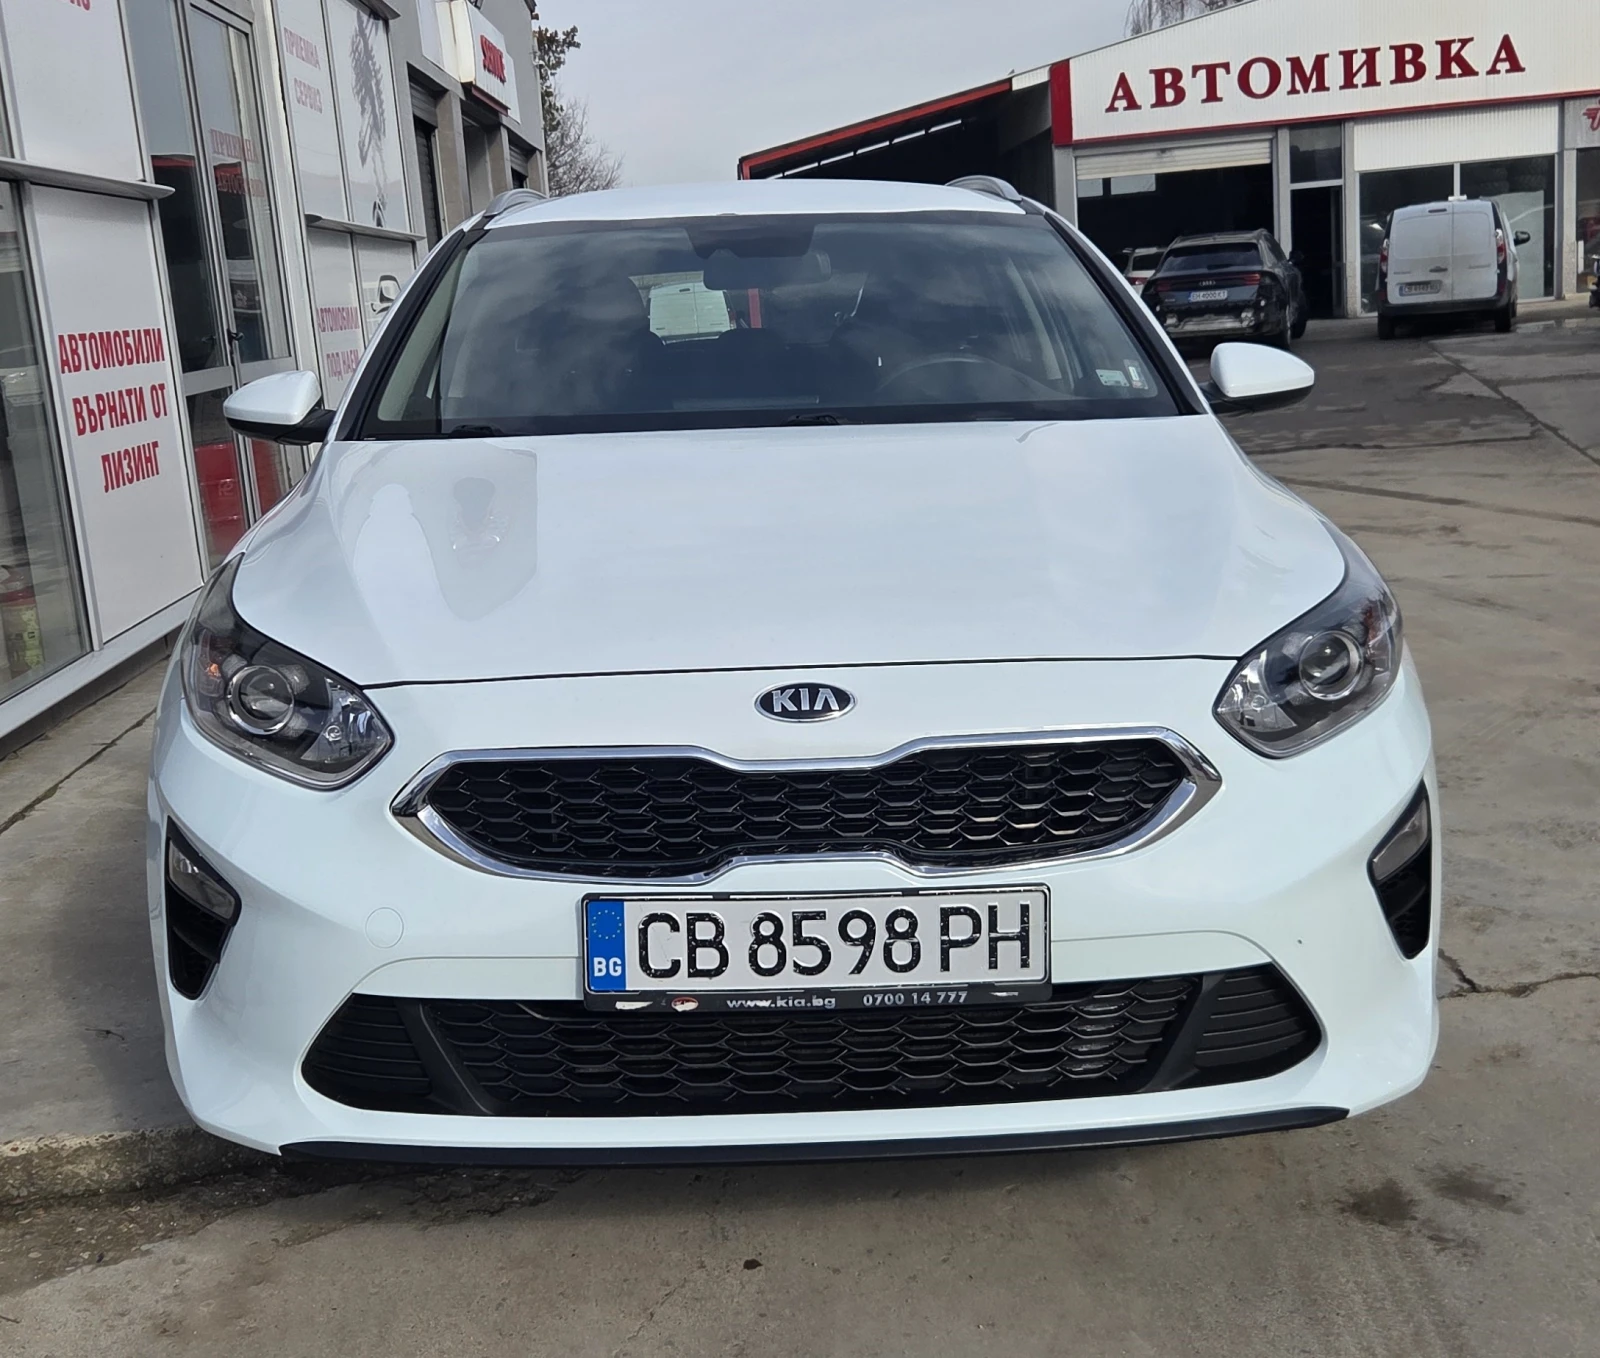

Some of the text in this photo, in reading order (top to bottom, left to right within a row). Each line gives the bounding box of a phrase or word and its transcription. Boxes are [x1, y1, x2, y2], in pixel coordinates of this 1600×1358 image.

[1105, 34, 1526, 113] АВТОМИВКА
[317, 306, 360, 332] АВТОМОБИЛИ
[58, 328, 165, 374] АВТОМОБИЛИ
[326, 351, 343, 381] ПОД
[72, 383, 168, 436] ВЪРНАТИ ОТ
[101, 441, 159, 493] ЛИЗИНГ
[772, 688, 840, 713] KIA
[638, 902, 1031, 979] CB 8598 PH
[593, 956, 623, 977] BG
[726, 991, 968, 1009] www.kia.bg 0700 14 777
